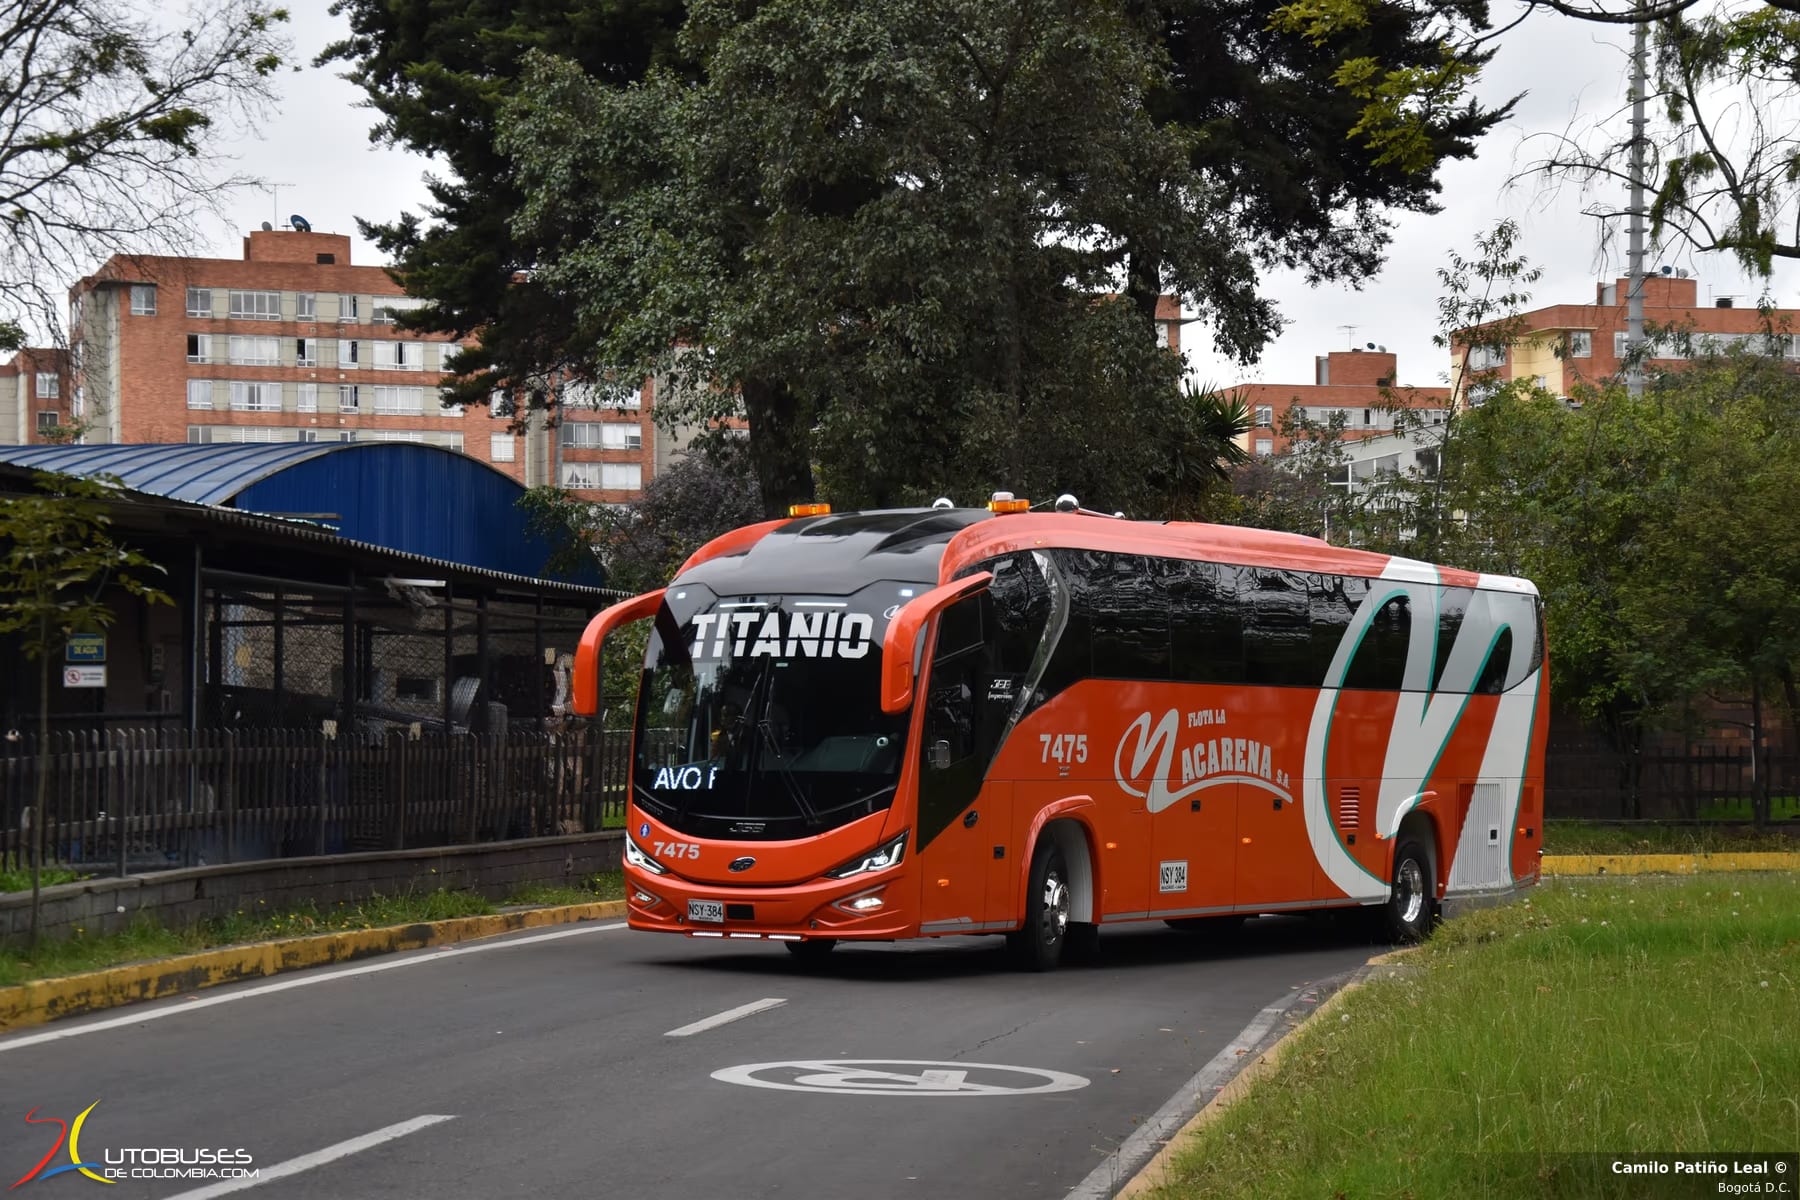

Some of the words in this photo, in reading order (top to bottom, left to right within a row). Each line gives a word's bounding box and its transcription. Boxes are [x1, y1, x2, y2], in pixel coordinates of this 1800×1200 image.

[691, 612, 873, 659] TITANIO
[1187, 709, 1214, 728] FLOTA
[1215, 709, 1226, 724] LA
[1040, 734, 1088, 764] 7475
[654, 767, 702, 789] AVO
[653, 841, 700, 860] 7475
[1161, 866, 1174, 885] NSY
